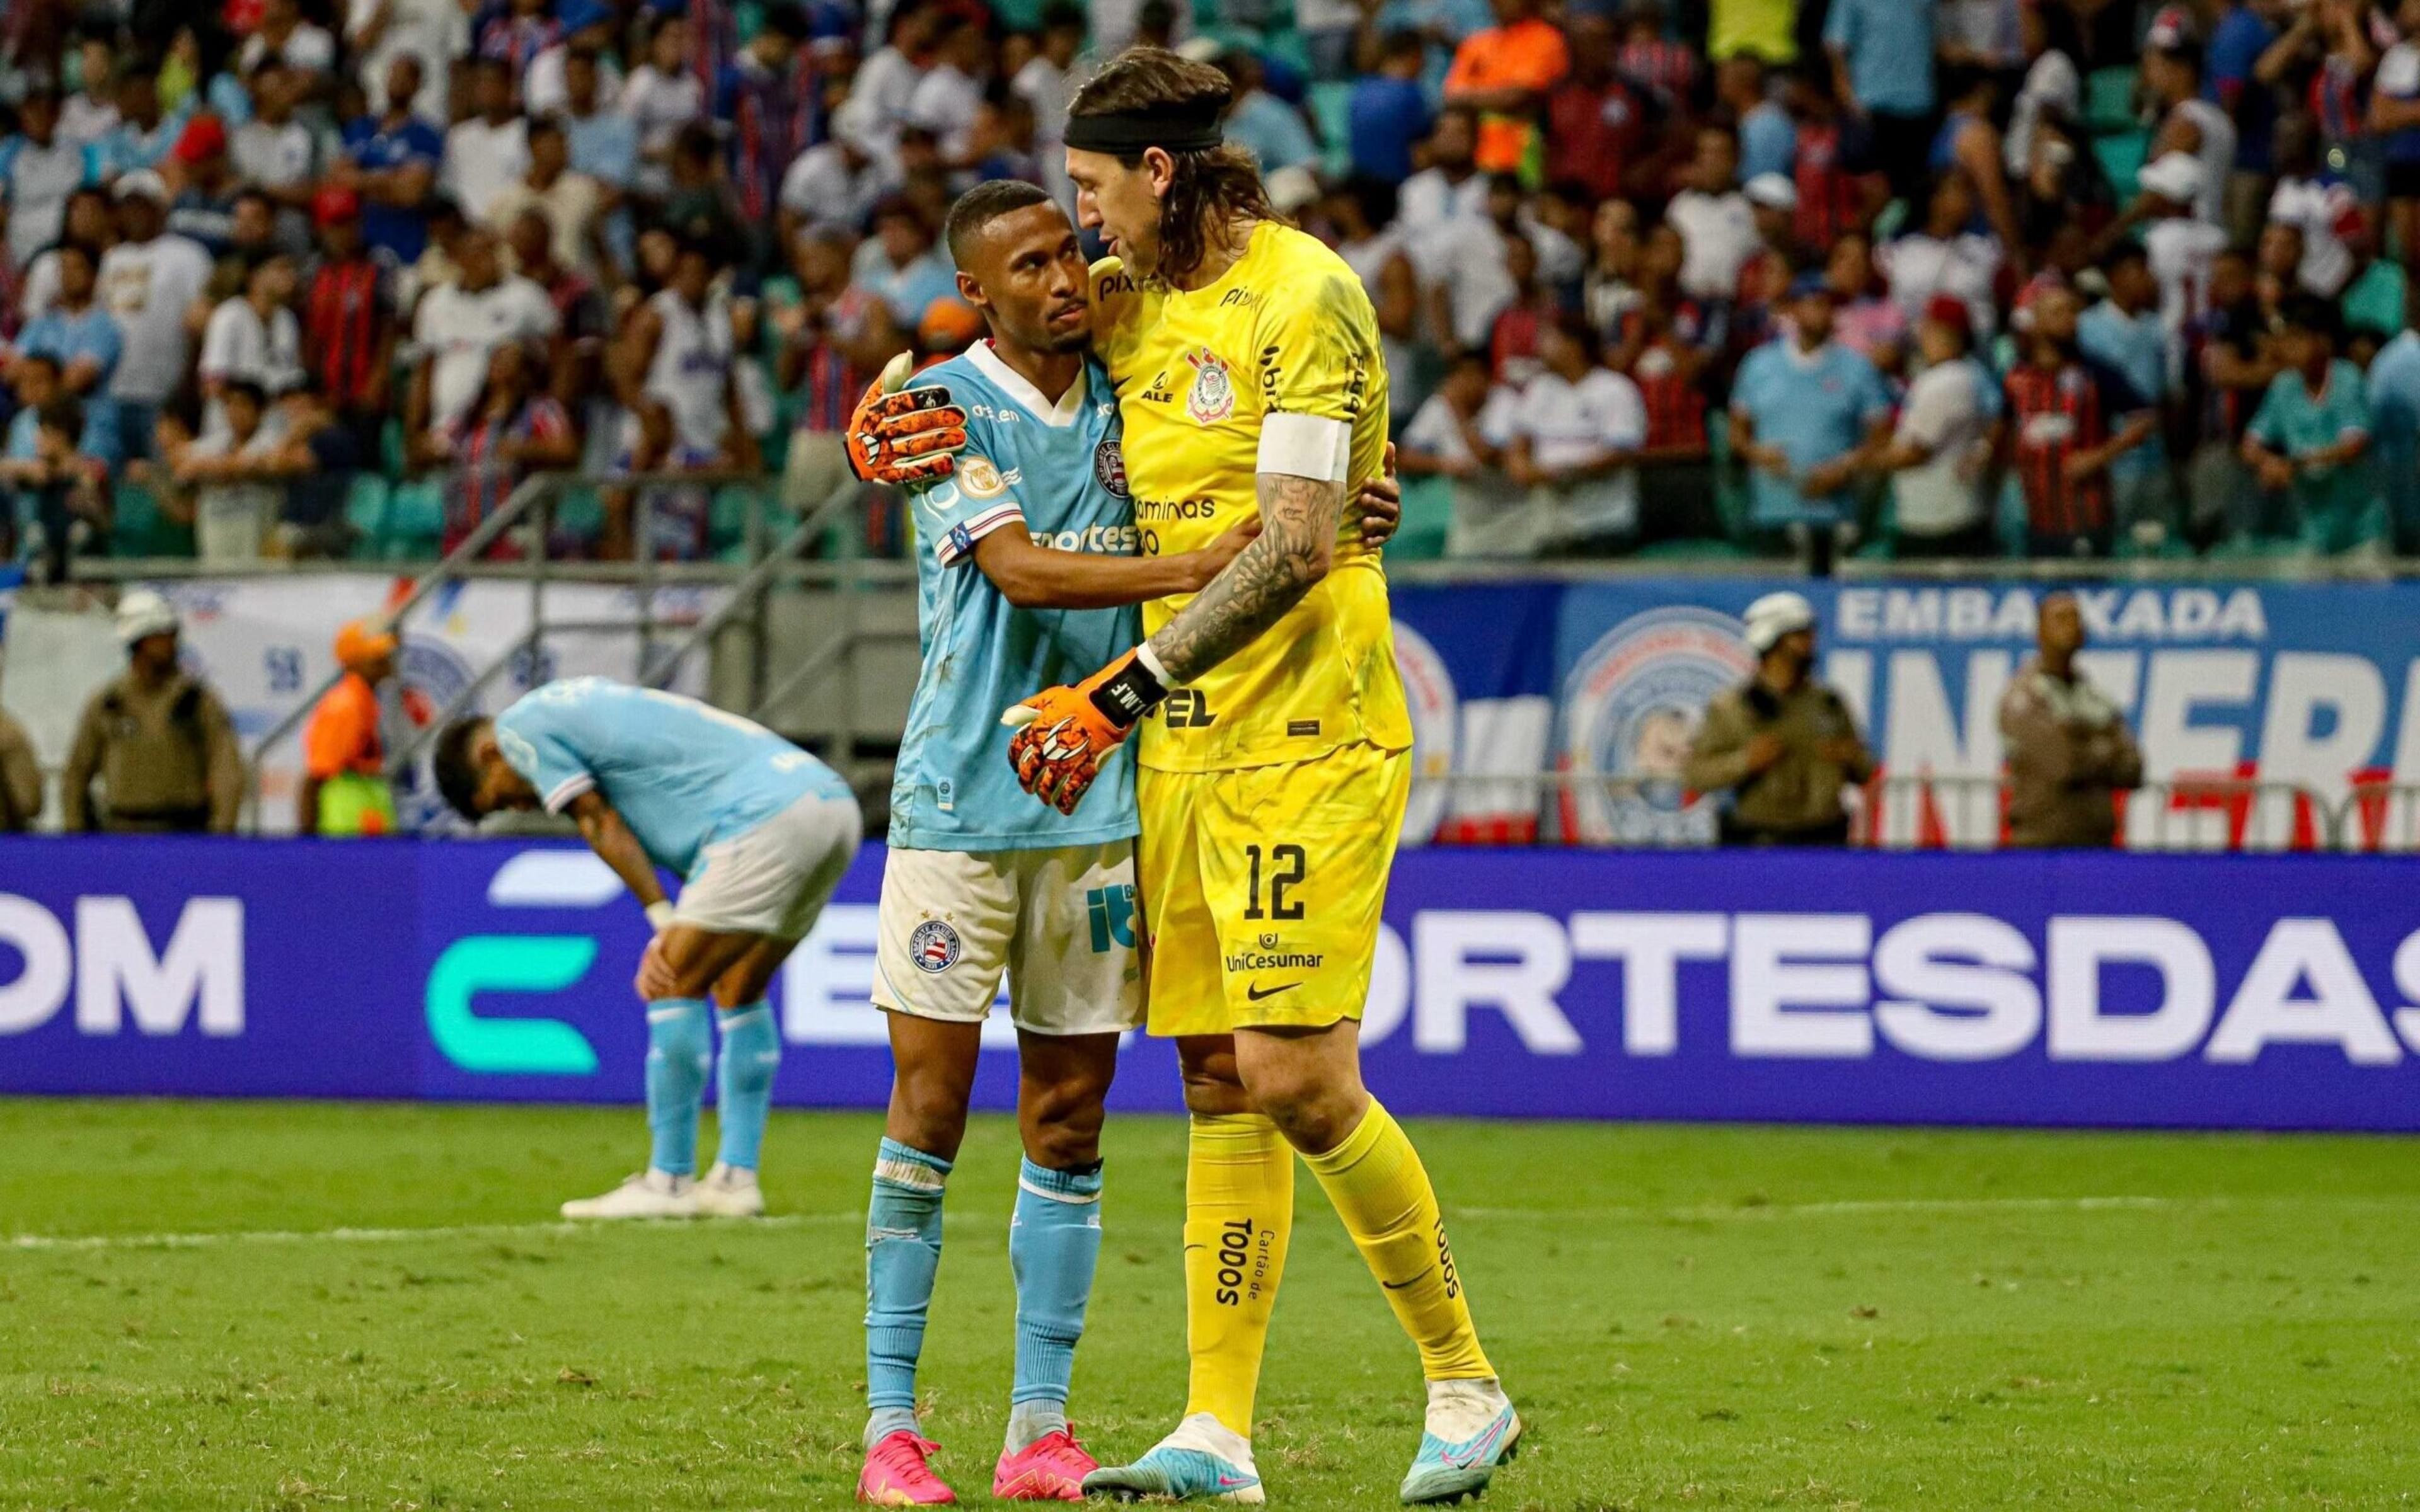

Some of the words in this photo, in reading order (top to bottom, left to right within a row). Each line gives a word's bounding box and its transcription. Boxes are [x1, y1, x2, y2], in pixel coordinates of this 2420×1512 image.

[1141, 390, 1173, 403] ALE
[1136, 495, 1215, 520] aminas
[1838, 588, 2264, 638] EMBAXADA
[1144, 689, 1218, 728] EL
[1243, 844, 1305, 920] 12
[1226, 952, 1323, 972] UniCesumar
[1216, 1218, 1253, 1306] TODOS
[1256, 1230, 1275, 1278] Cartão
[1248, 1282, 1261, 1300] de
